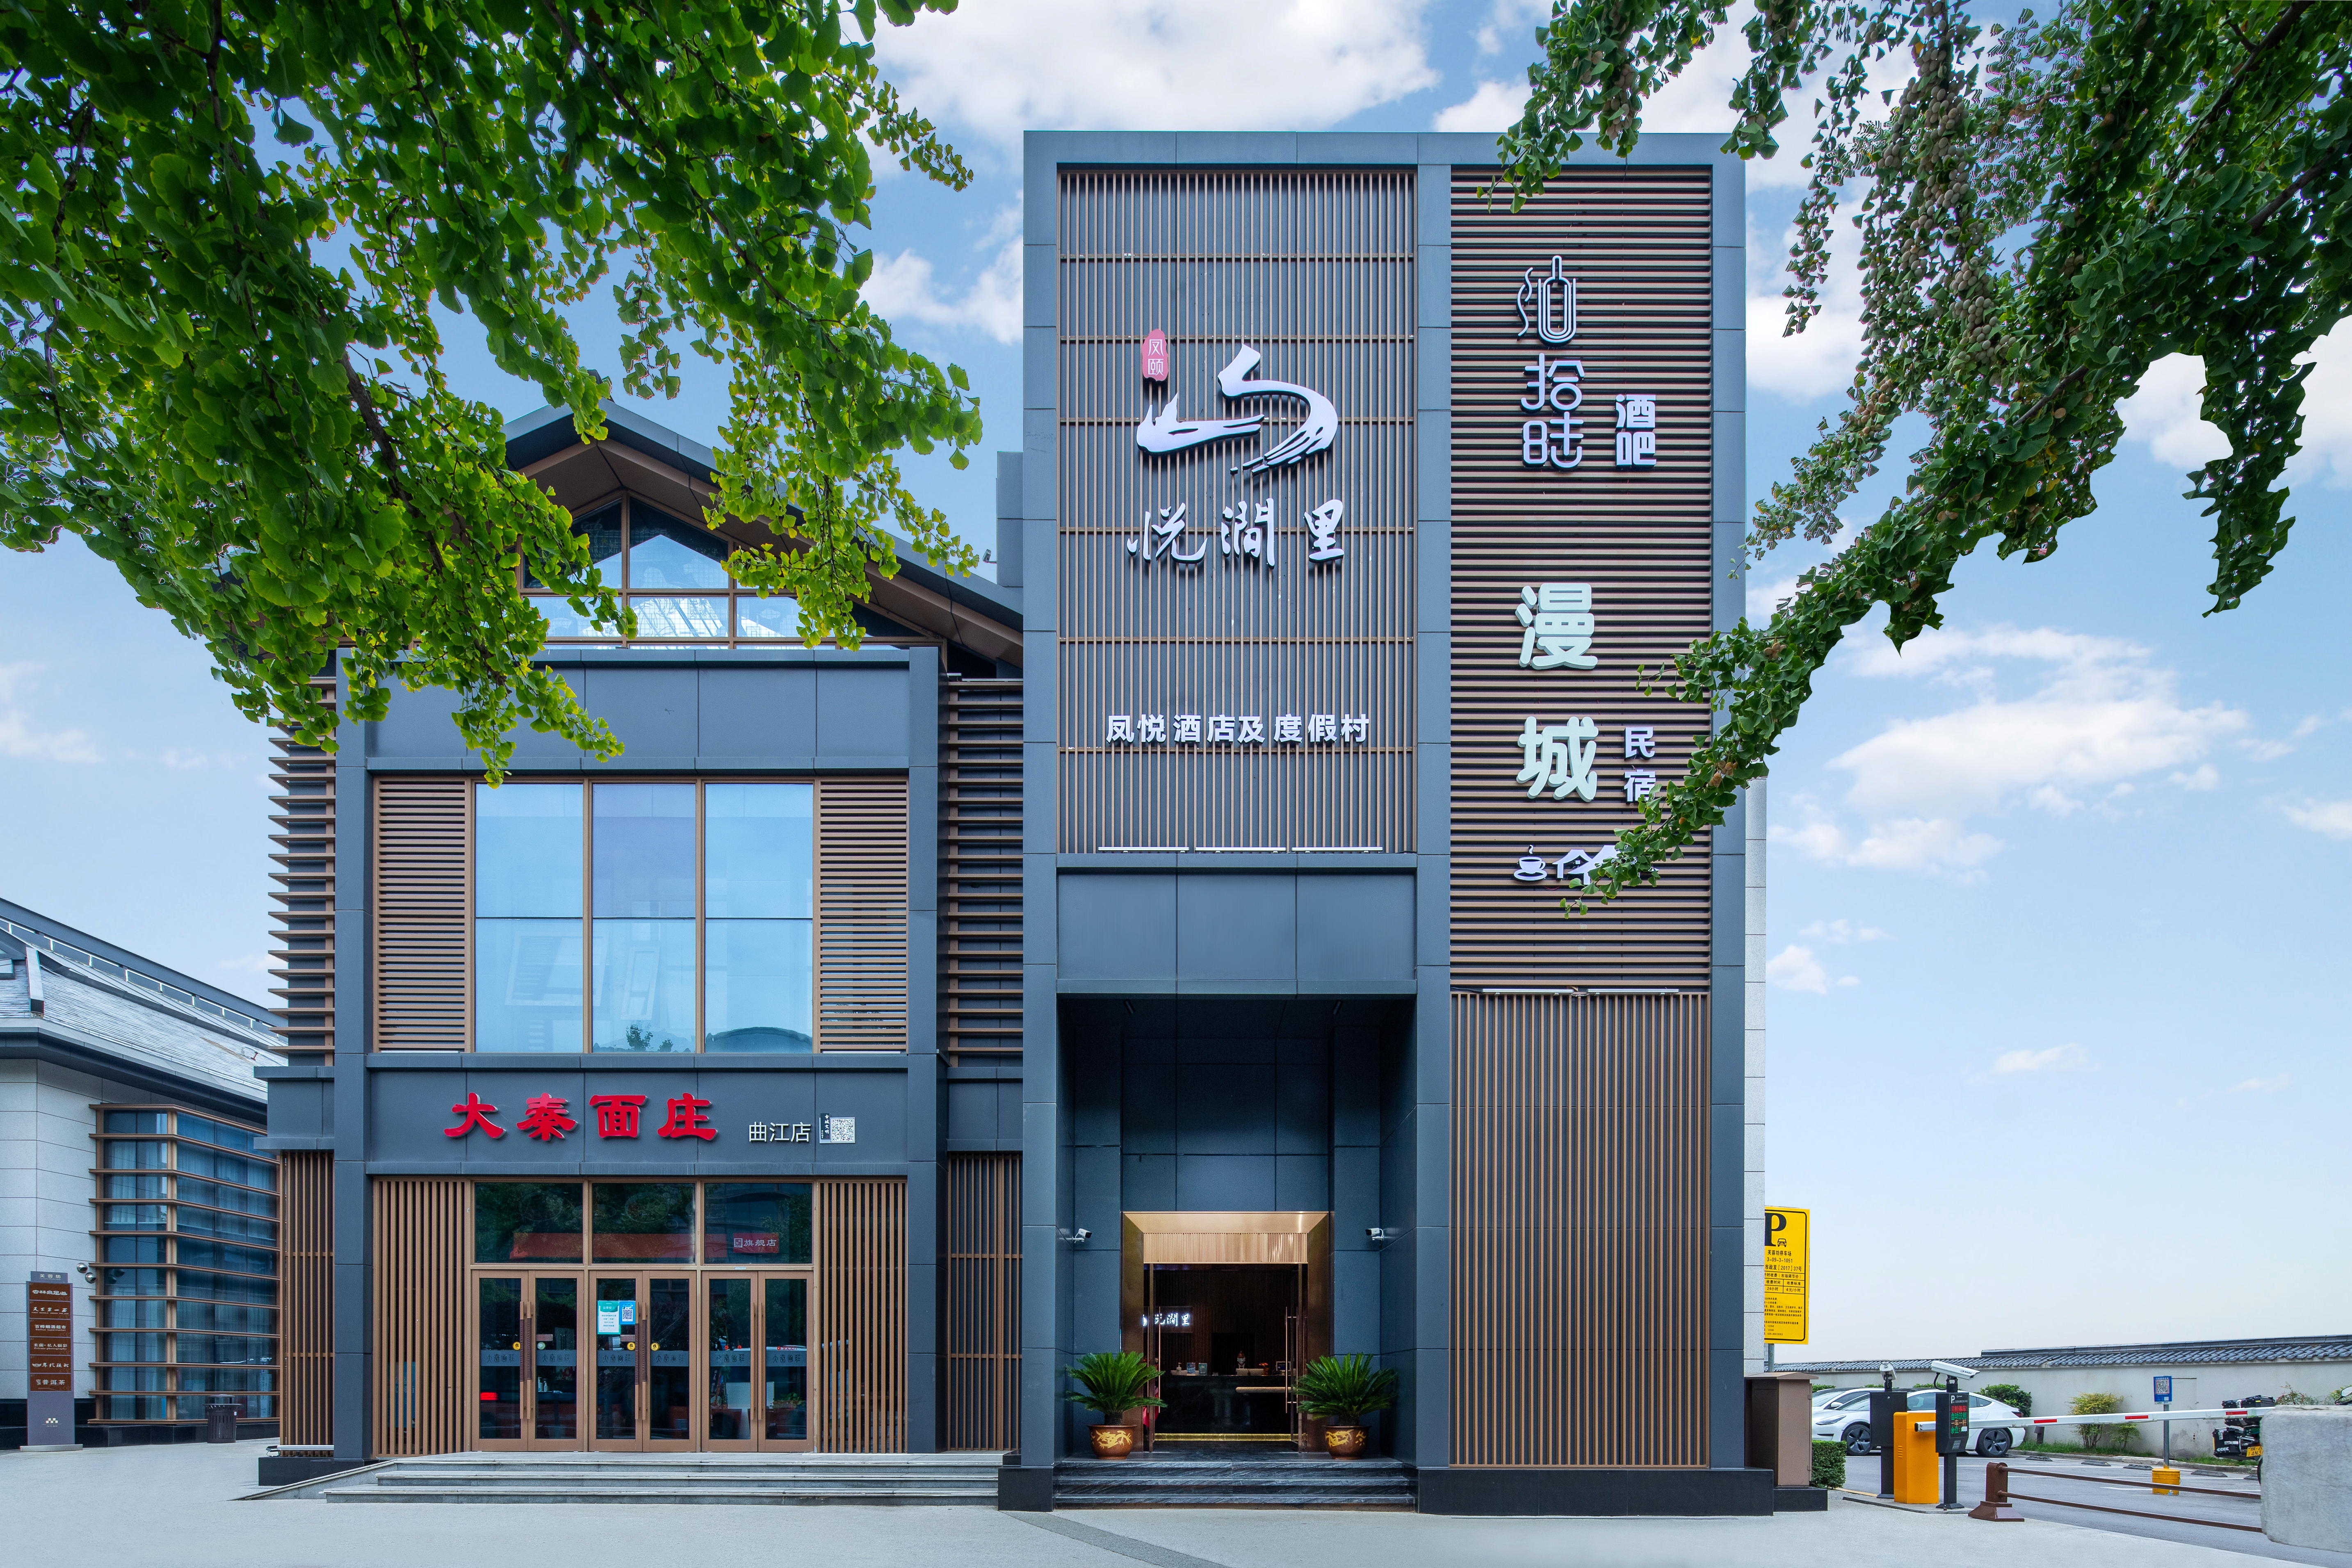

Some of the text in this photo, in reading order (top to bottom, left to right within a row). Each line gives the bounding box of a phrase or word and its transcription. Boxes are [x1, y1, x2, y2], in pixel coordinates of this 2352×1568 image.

[1148, 339, 1164, 376] 凤颐
[1615, 394, 1656, 467] 酒吧
[1515, 583, 1599, 802] 漫城
[1106, 713, 1369, 743] 凤悦酒店及度假村
[1624, 726, 1656, 802] 民宿
[444, 1092, 719, 1141] 大秦面庄
[748, 1122, 811, 1143] 曲江店
[1764, 1213, 1787, 1246] P
